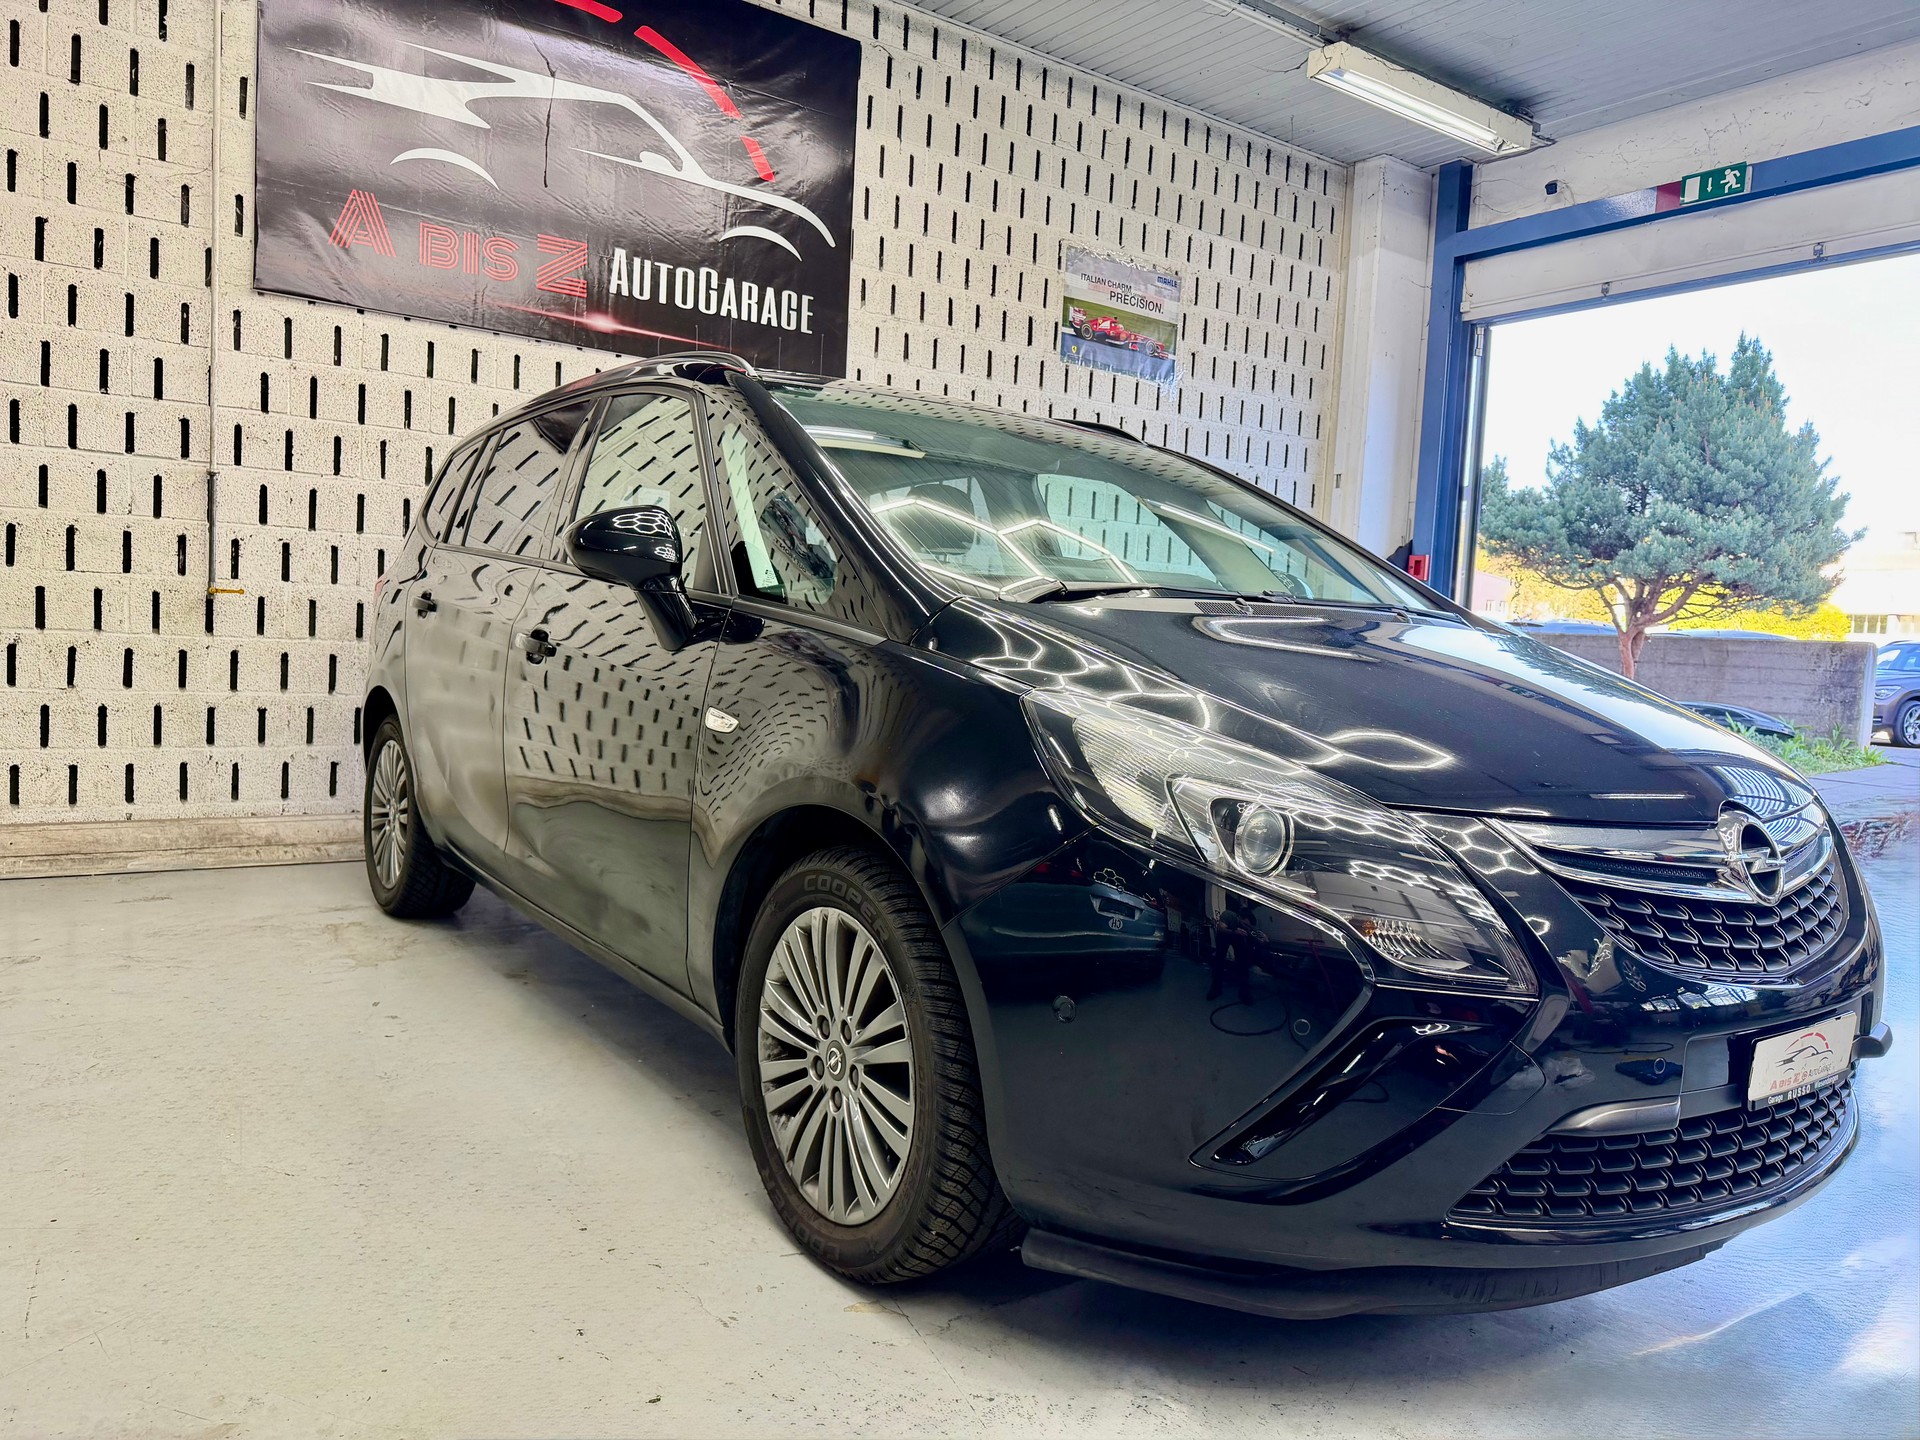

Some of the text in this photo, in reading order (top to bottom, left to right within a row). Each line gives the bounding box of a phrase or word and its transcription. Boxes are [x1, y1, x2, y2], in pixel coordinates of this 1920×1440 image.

[328, 189, 397, 258] A
[418, 222, 519, 282] BIS
[536, 233, 588, 299] Z
[1080, 272, 1107, 287] ITALIAN
[1109, 290, 1164, 314] PRECISION.
[803, 874, 890, 943] COOPER
[1768, 1094, 1784, 1105] Garage
[1787, 1084, 1811, 1100] RUSSO
[1769, 1079, 1778, 1091] A
